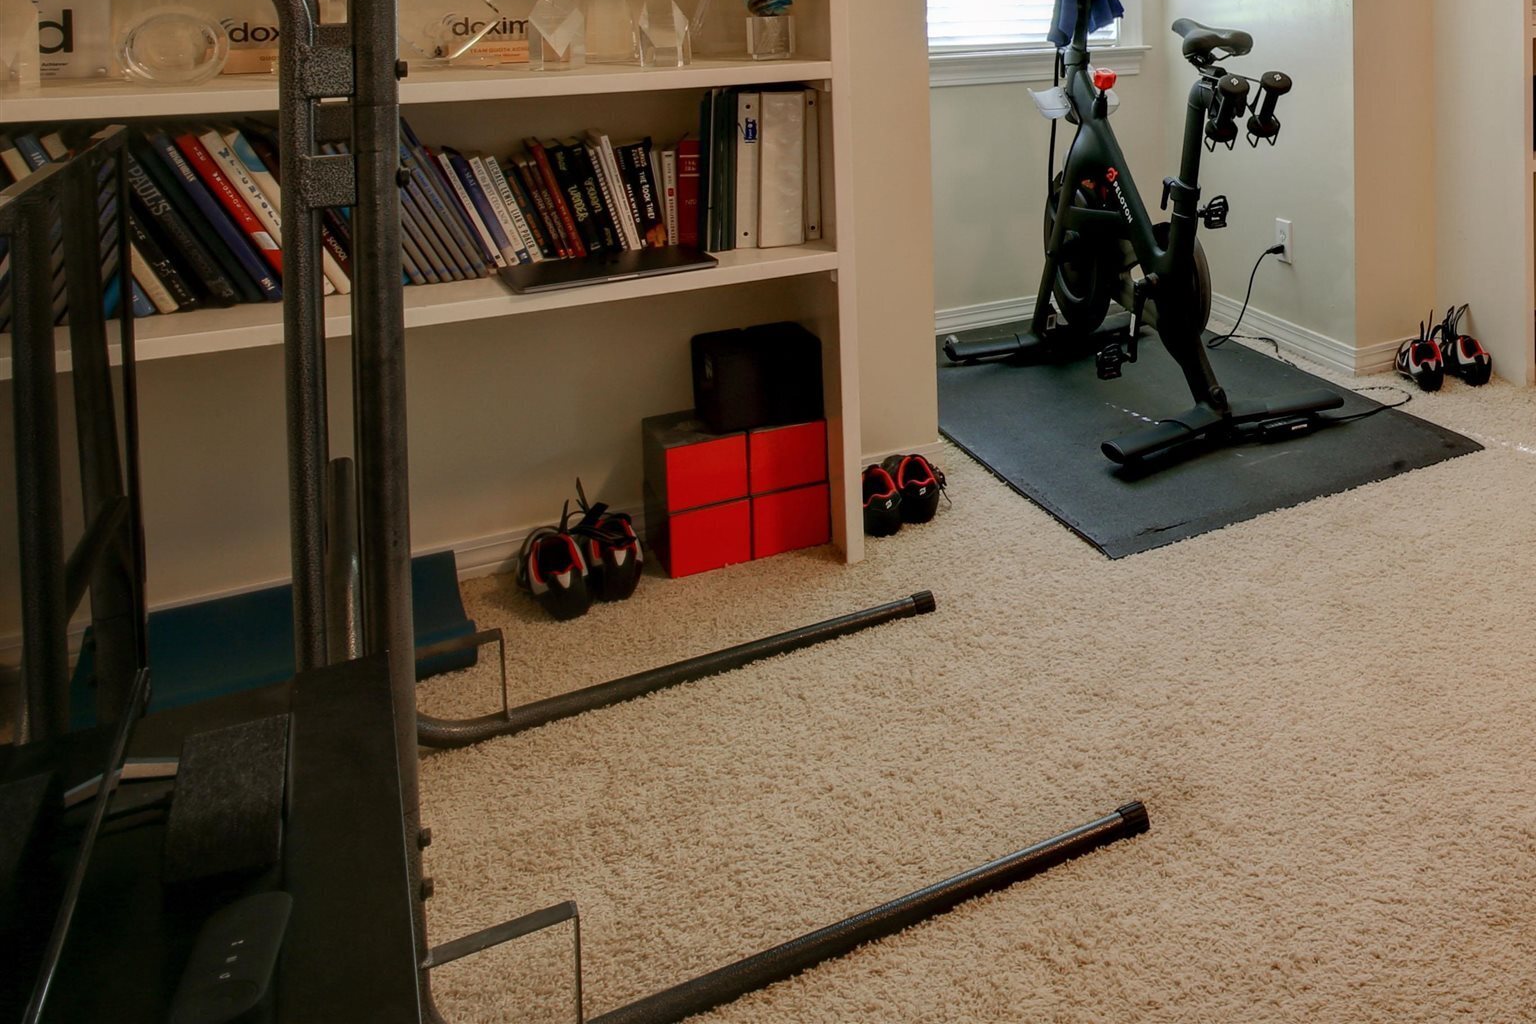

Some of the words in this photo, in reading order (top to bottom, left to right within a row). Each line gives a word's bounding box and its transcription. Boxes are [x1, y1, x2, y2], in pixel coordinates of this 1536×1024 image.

[128, 166, 171, 216] PAUL'S
[638, 170, 647, 184] THE
[641, 184, 652, 200] BOOK
[488, 160, 503, 185] MICHAEL
[501, 187, 513, 205] LEWIS
[511, 208, 524, 228] LIAR'S
[521, 229, 534, 248] POKER
[567, 184, 588, 222] WONDER
[626, 183, 641, 223] MILKWEED
[1113, 180, 1133, 223] PELOTON
